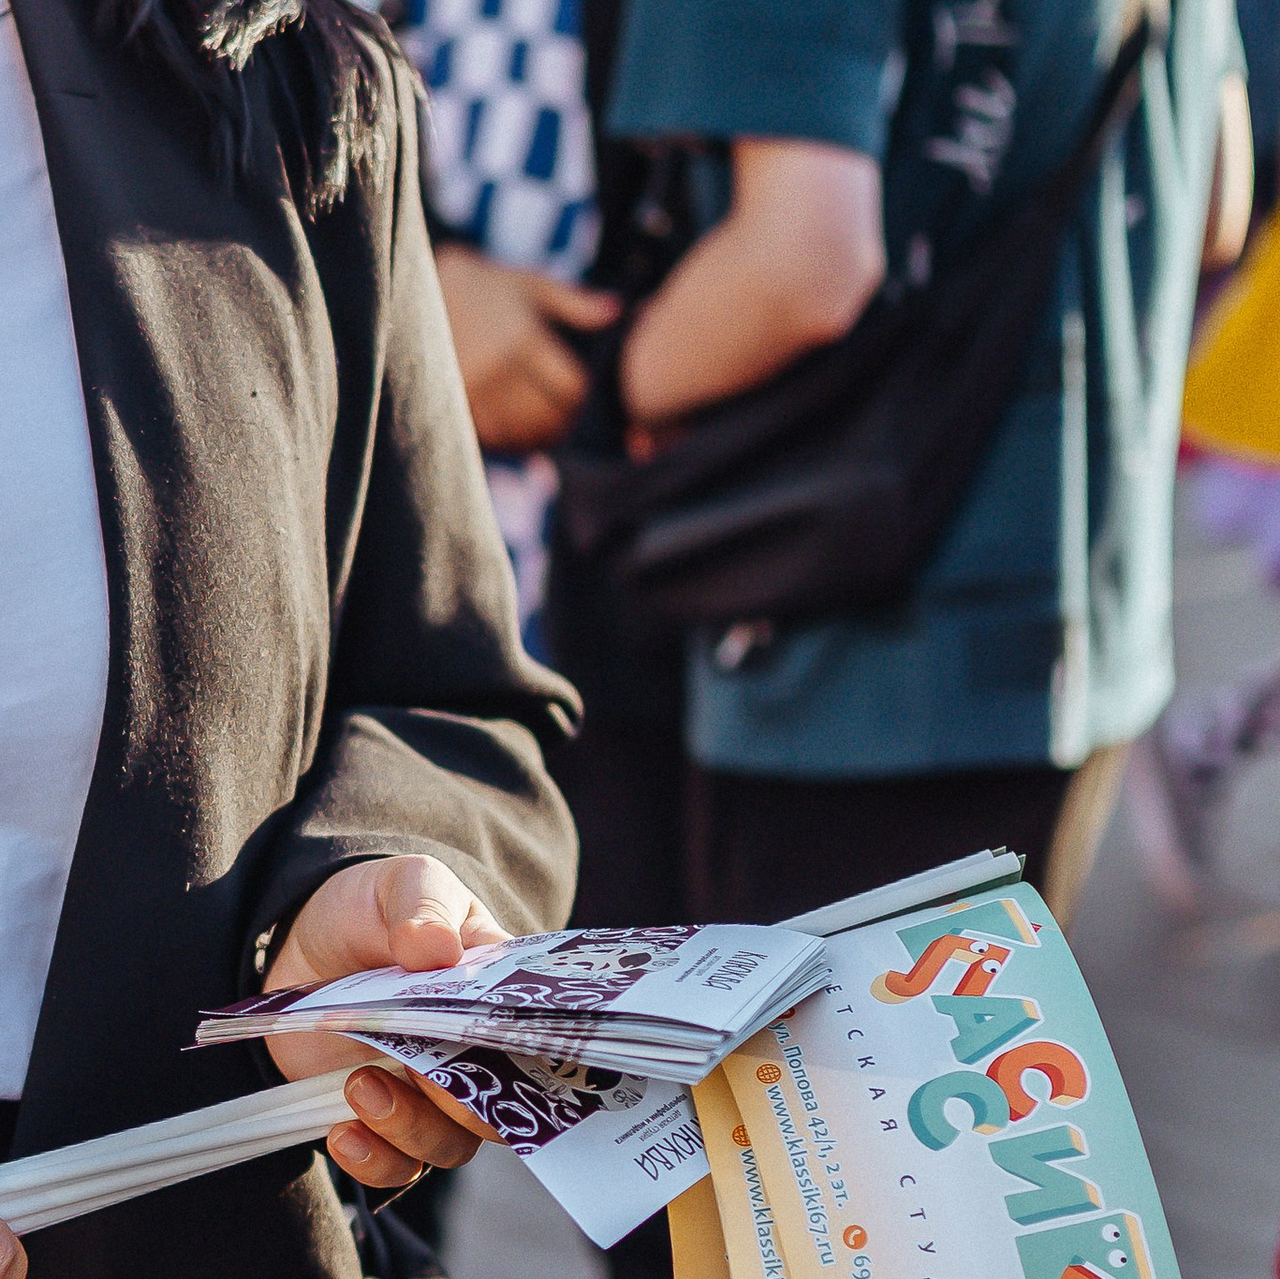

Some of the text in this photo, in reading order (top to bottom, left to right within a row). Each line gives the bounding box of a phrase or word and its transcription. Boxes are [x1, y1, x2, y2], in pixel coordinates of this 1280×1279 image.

[701, 950, 769, 991] КЛЮКВА
[824, 967, 899, 1132] ЕТСКАЯ
[633, 1116, 705, 1181] ЛЮКВА
[767, 1021, 849, 1209] ул. Попова 42/1, 2 эт.
[767, 1084, 835, 1266] www.klassiki67.ru
